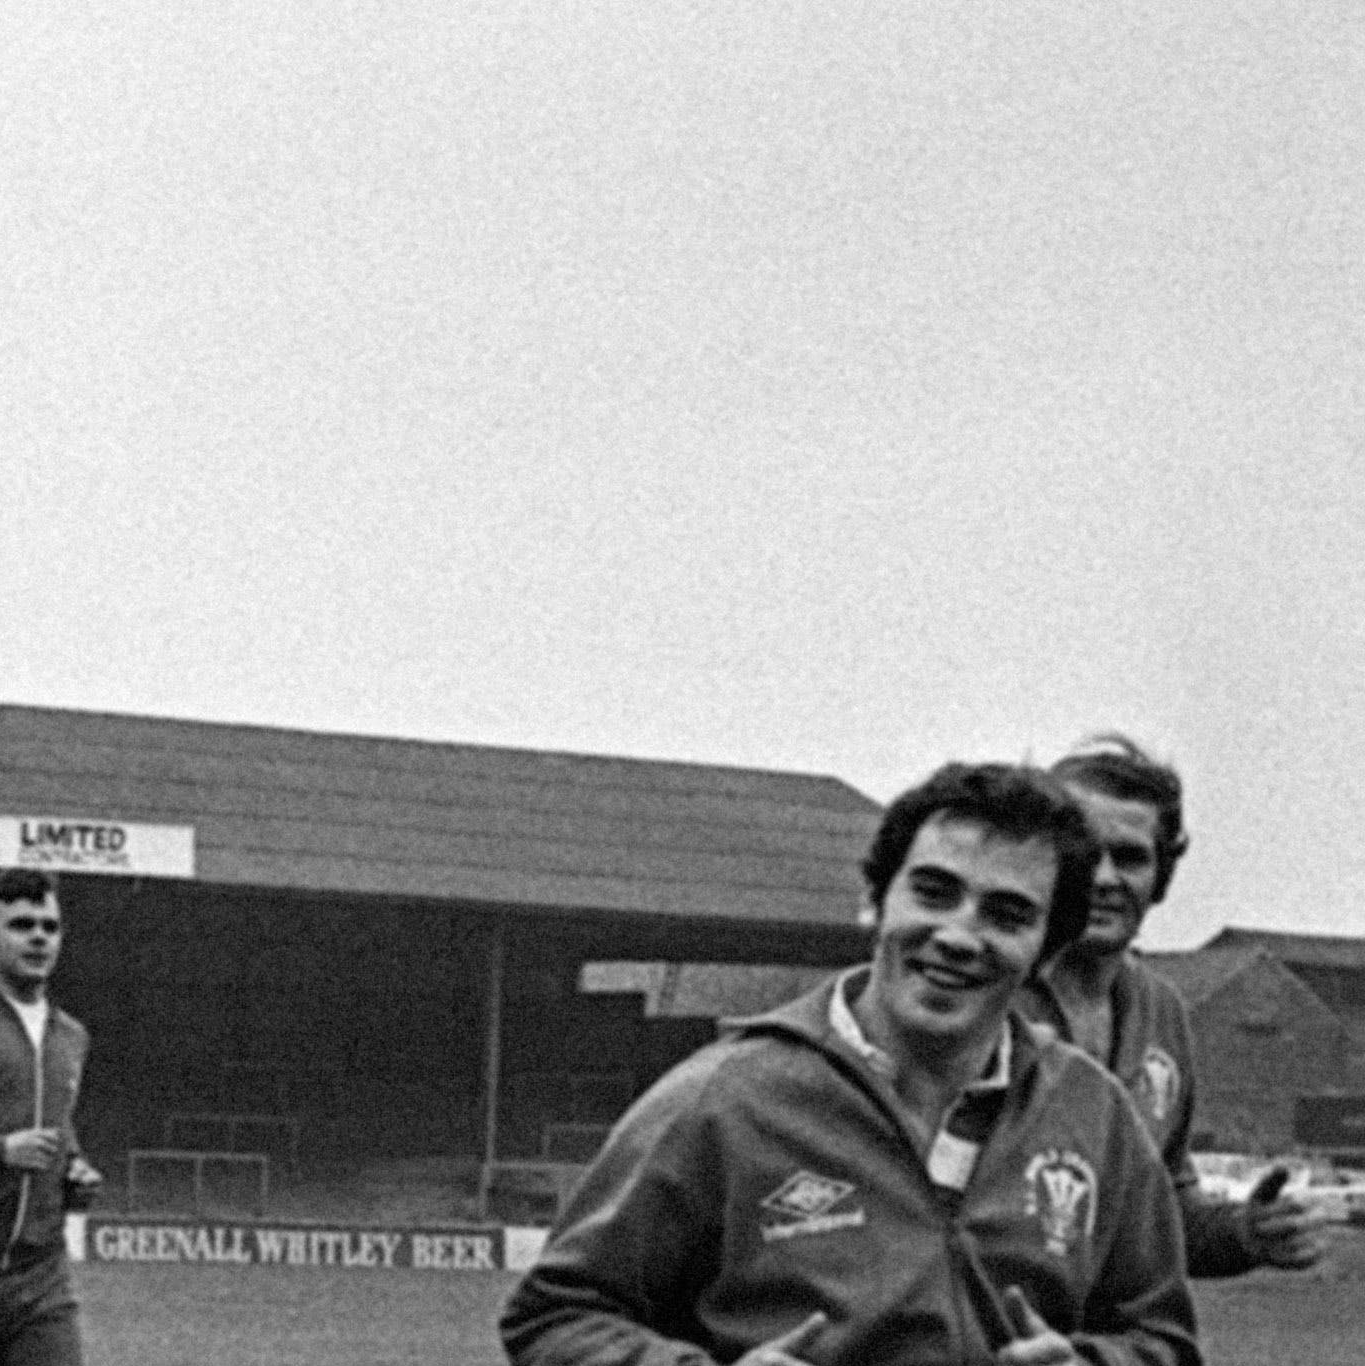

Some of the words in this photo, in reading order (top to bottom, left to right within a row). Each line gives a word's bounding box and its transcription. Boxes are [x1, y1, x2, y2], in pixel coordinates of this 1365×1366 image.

[20, 820, 127, 851] LIMITED
[94, 1225, 253, 1264] GREENALL
[256, 1229, 402, 1269] WHITLEY
[412, 1233, 495, 1270] BEER
